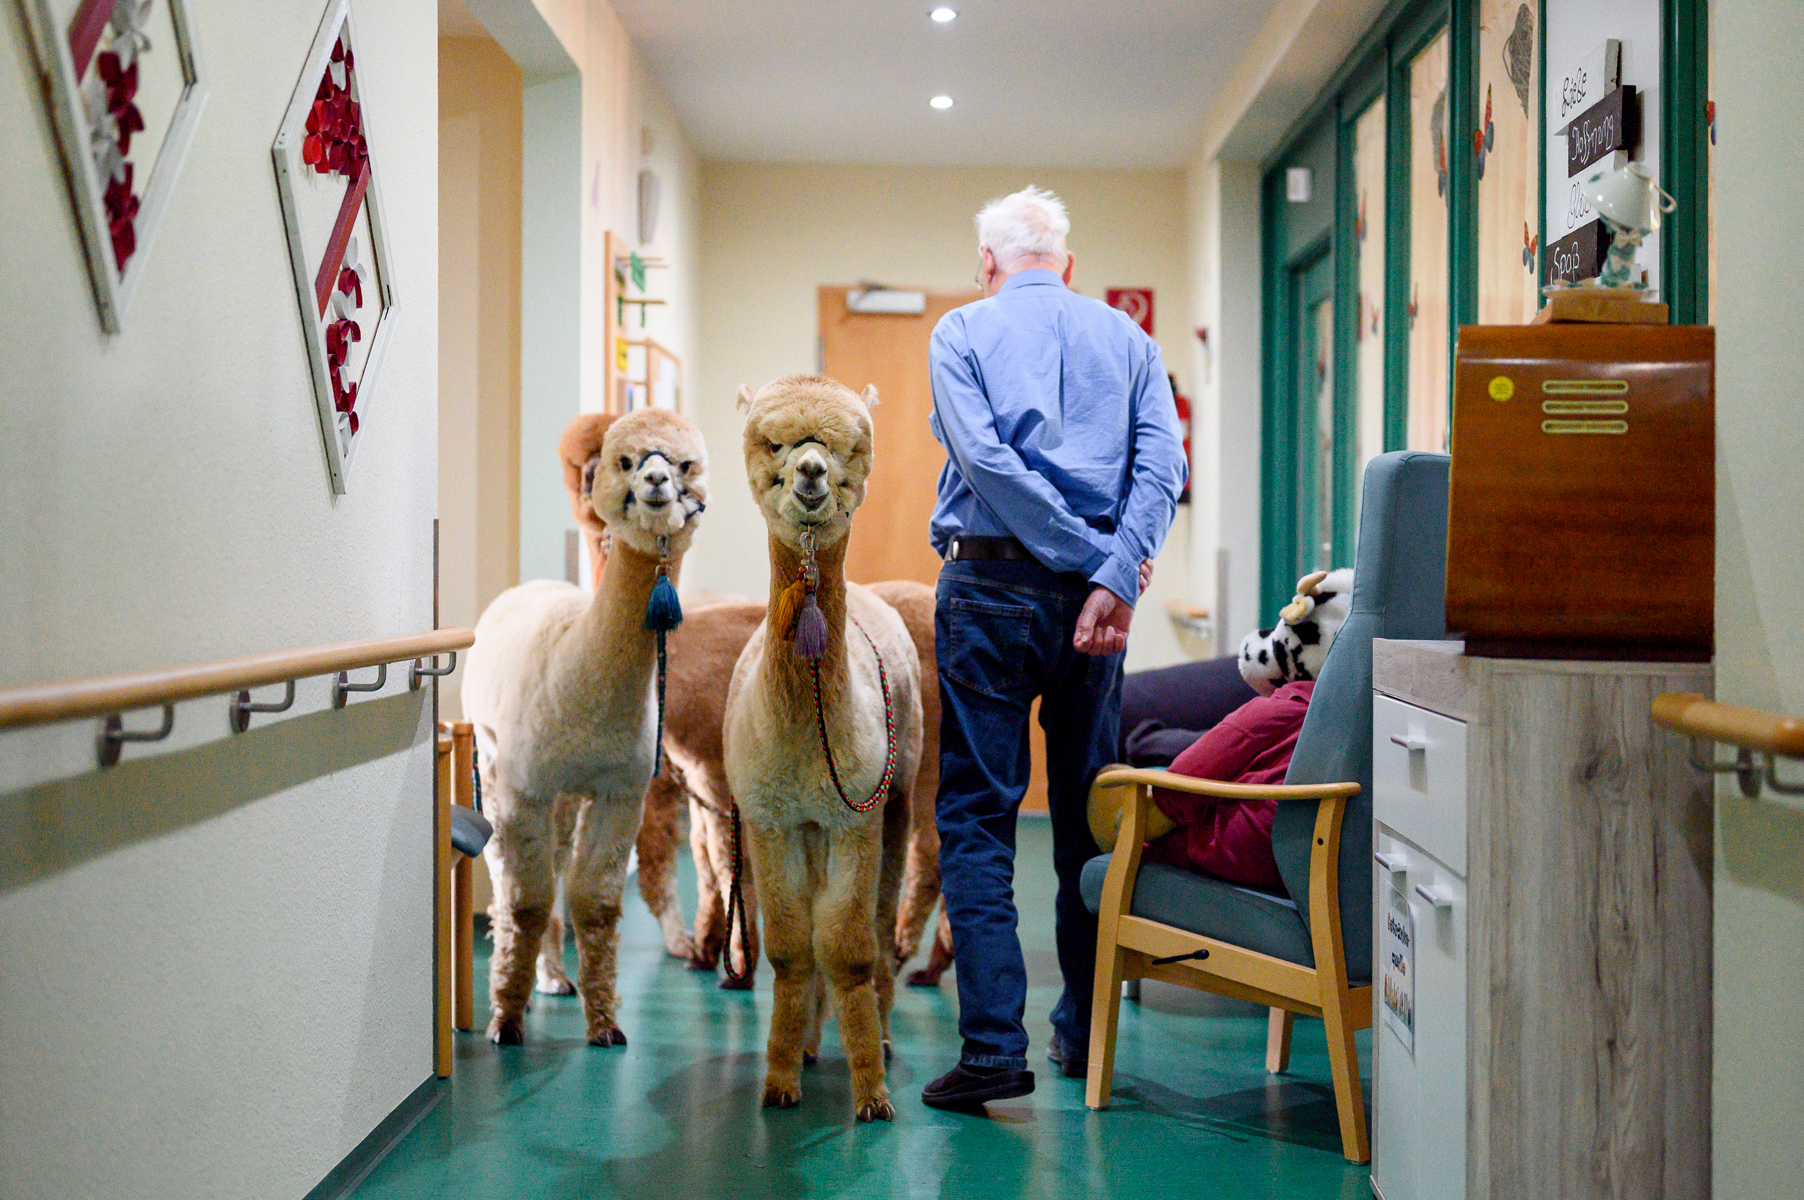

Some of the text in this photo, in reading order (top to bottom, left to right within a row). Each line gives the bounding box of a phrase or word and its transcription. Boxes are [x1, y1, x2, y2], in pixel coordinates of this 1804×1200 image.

[1561, 67, 1587, 118] Liebe
[1571, 114, 1614, 166] Hoffnung
[1550, 241, 1580, 287] Spaß
